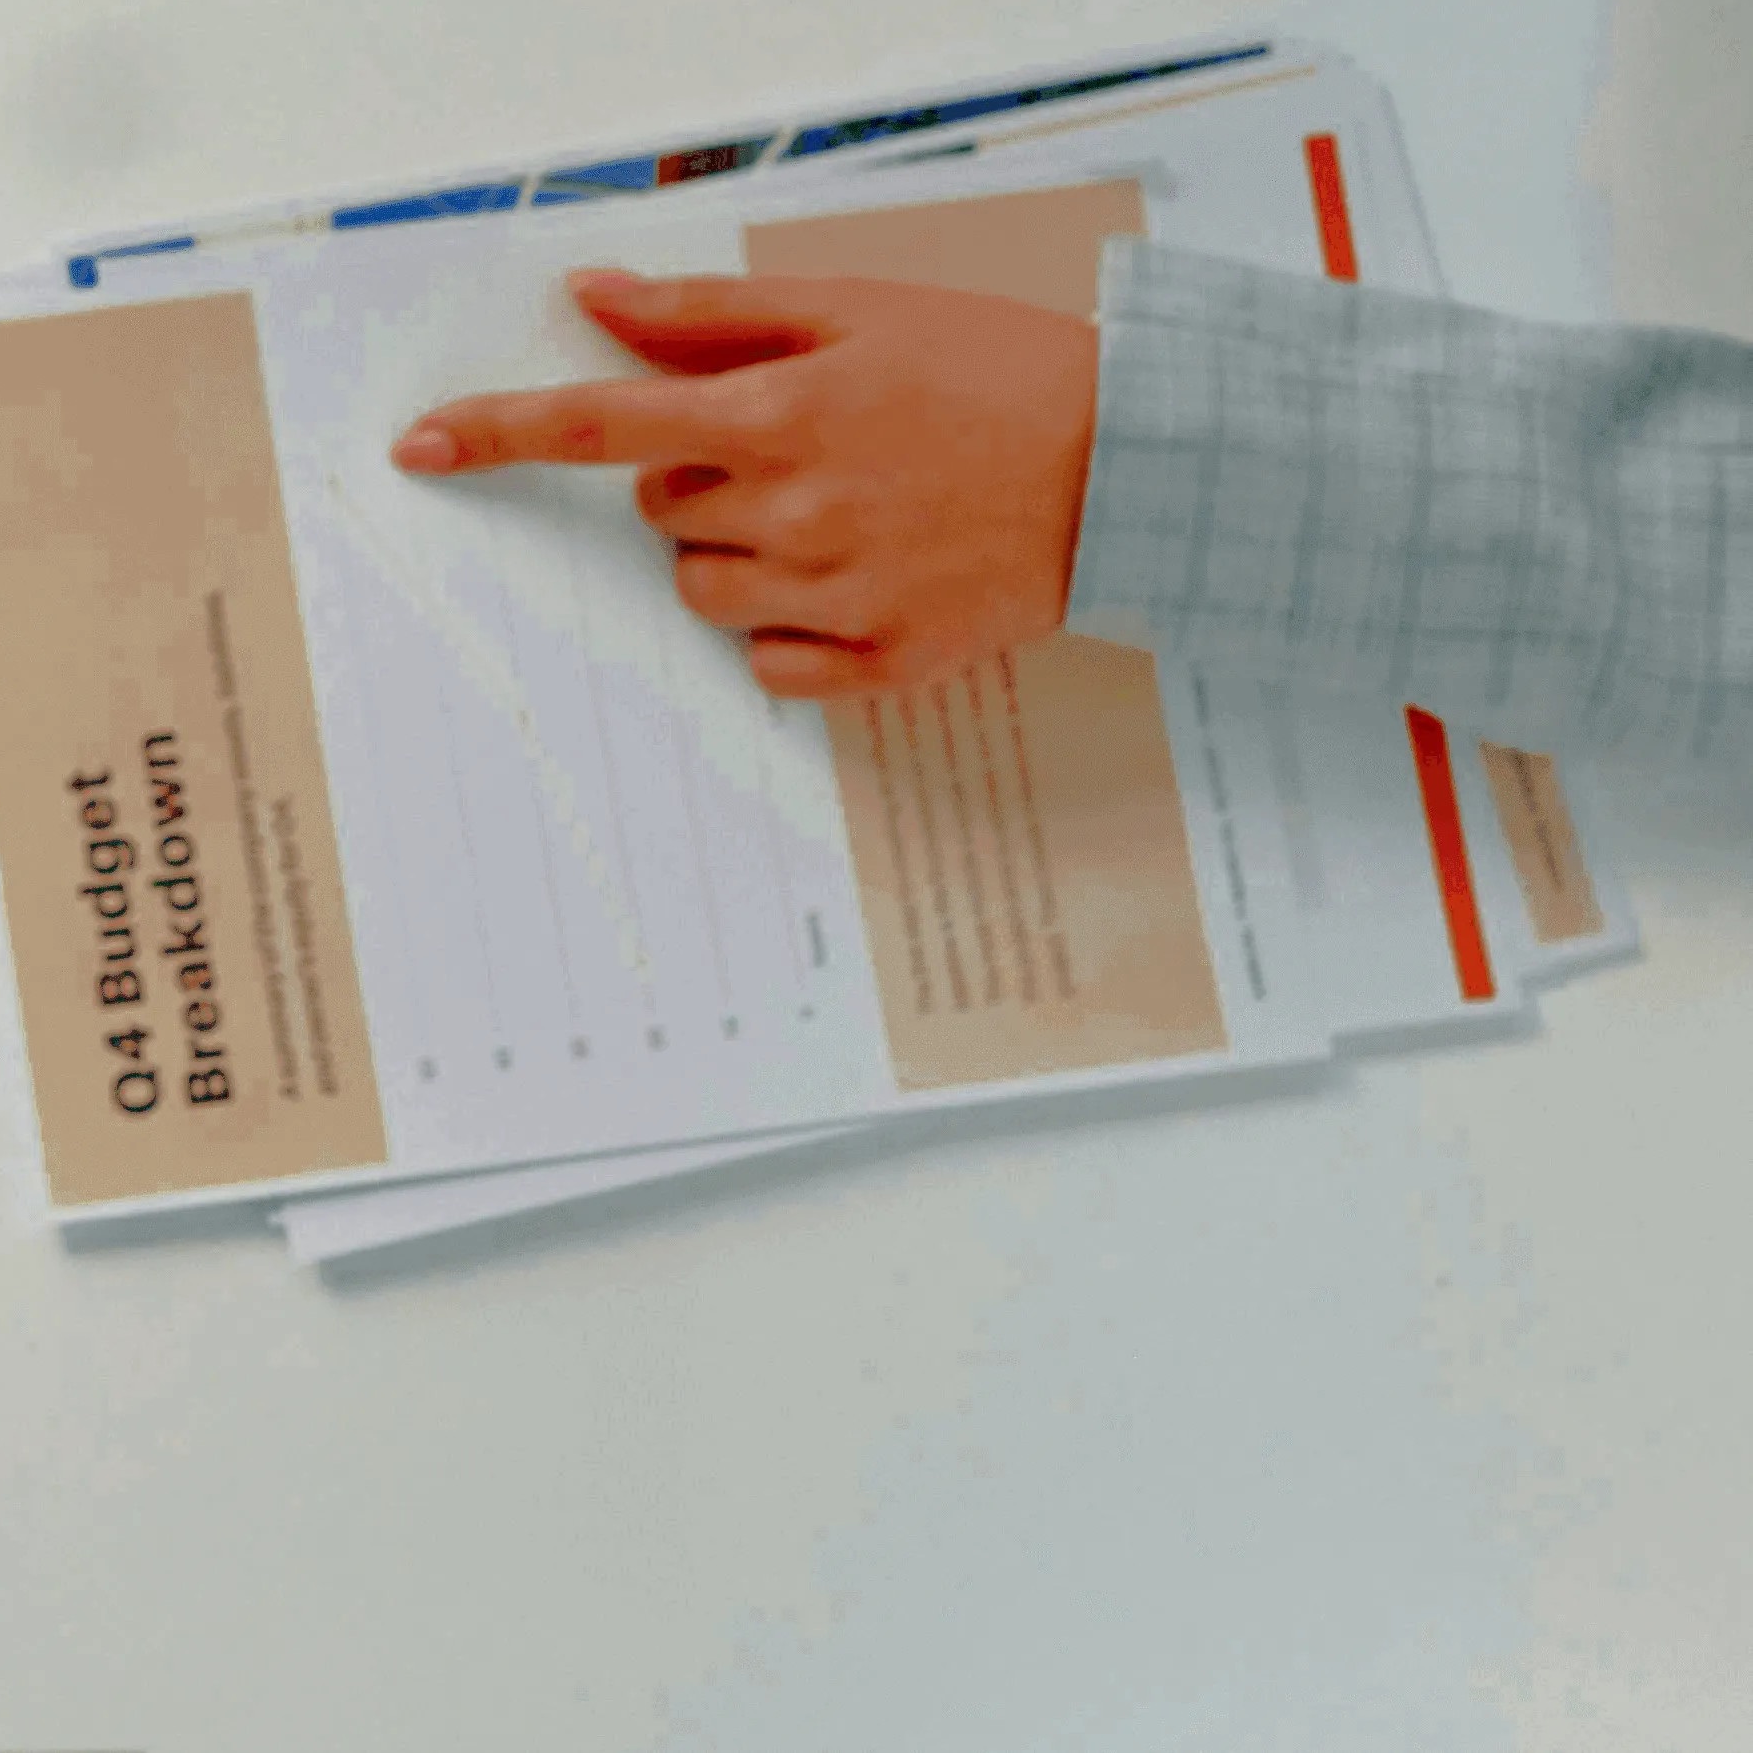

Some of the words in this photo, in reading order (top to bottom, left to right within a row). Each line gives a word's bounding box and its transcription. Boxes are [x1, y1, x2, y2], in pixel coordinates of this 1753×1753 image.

[66, 768, 141, 1008] Budget
[141, 729, 233, 1106] Breakdown
[112, 1028, 163, 1116] Q4
